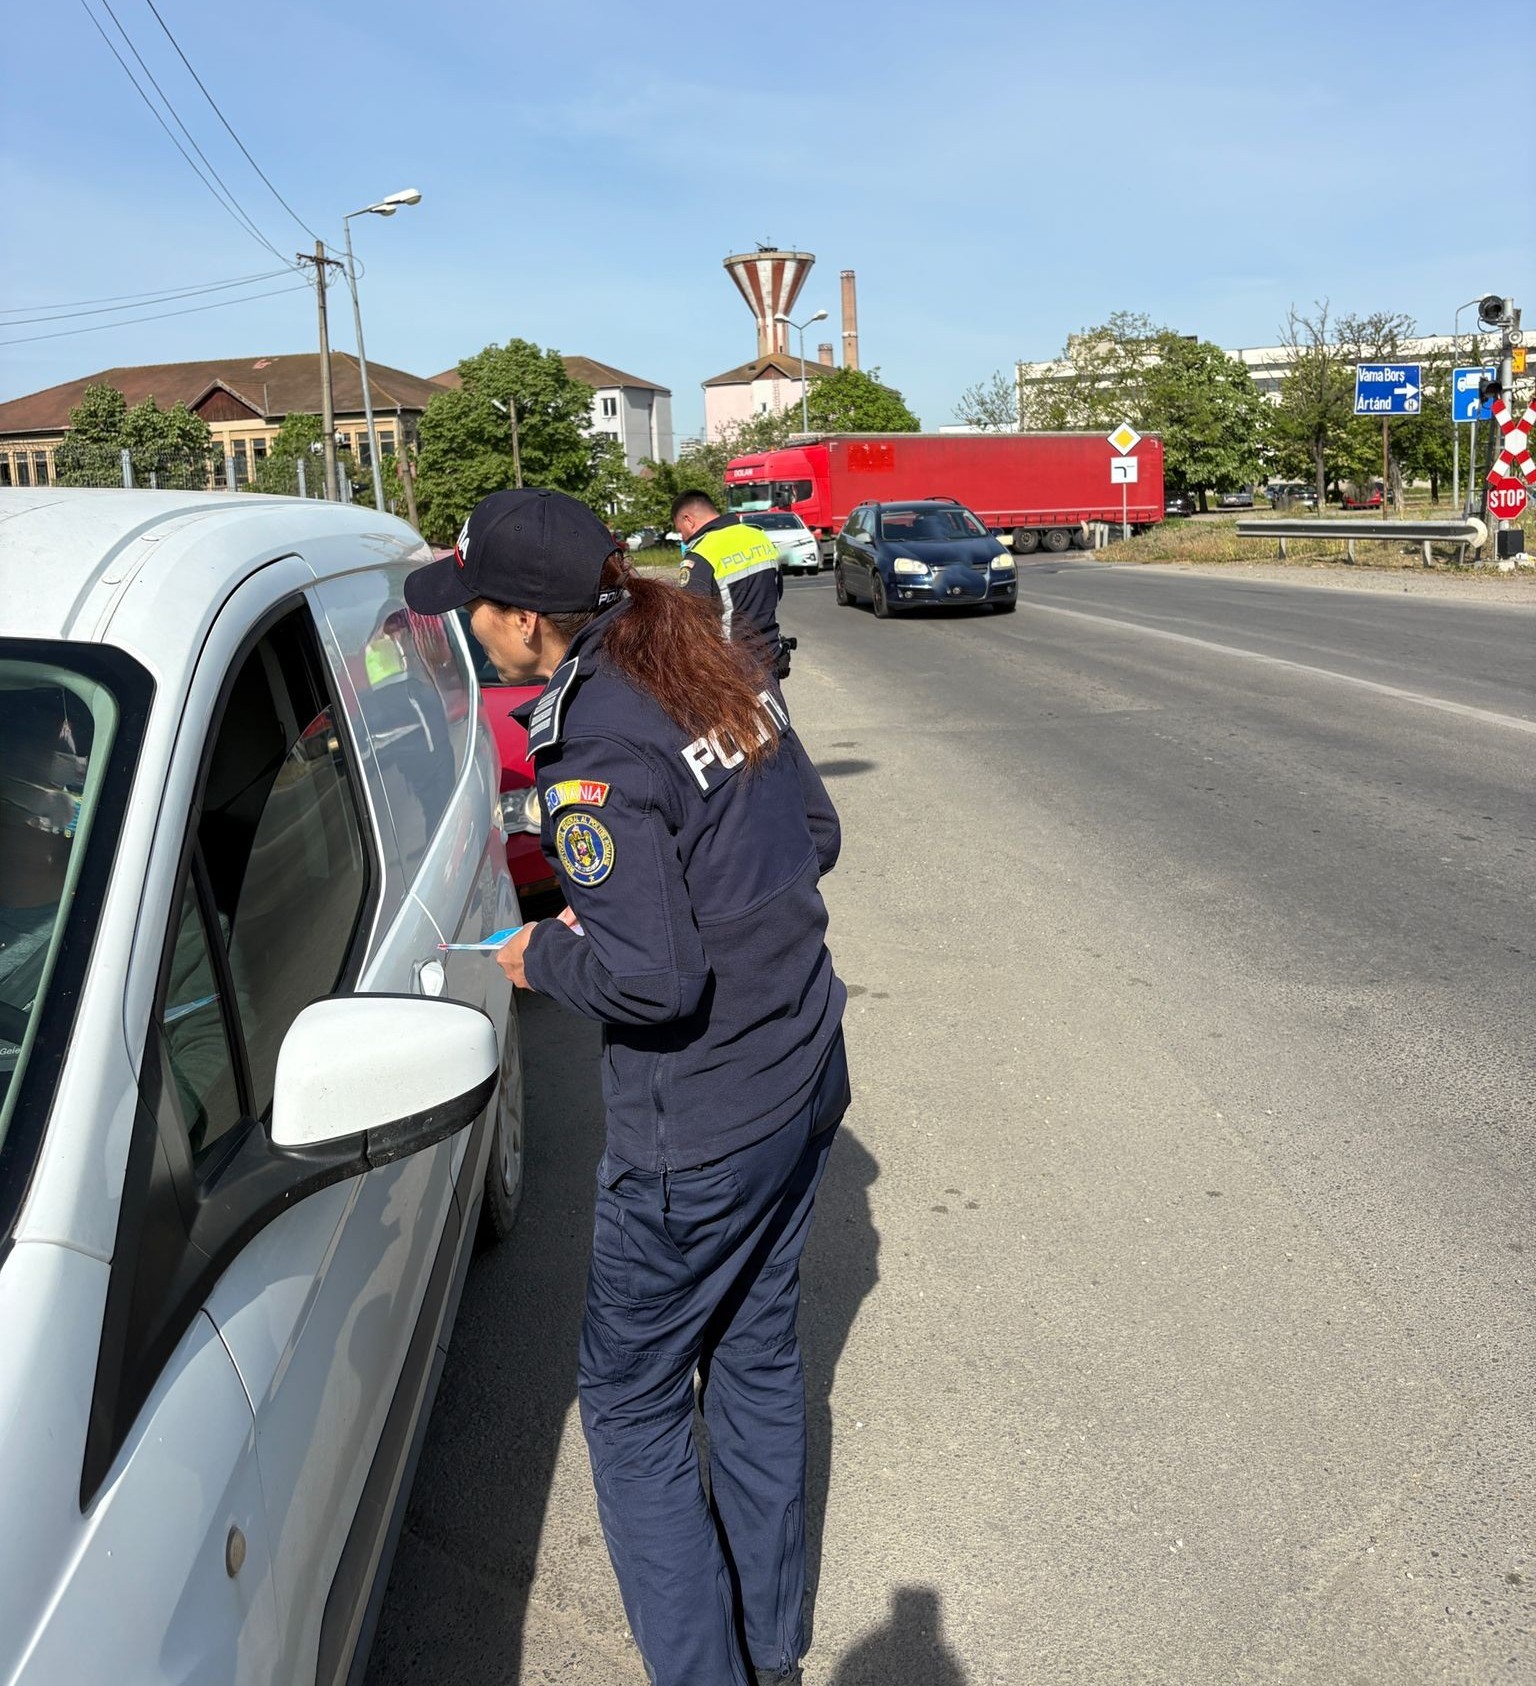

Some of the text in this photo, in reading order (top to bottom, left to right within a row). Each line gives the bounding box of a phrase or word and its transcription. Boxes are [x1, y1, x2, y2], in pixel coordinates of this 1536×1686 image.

[1359, 368, 1383, 382] Vama
[1357, 393, 1392, 411] Ártánd
[1408, 401, 1414, 410] H
[1490, 489, 1525, 508] STOP
